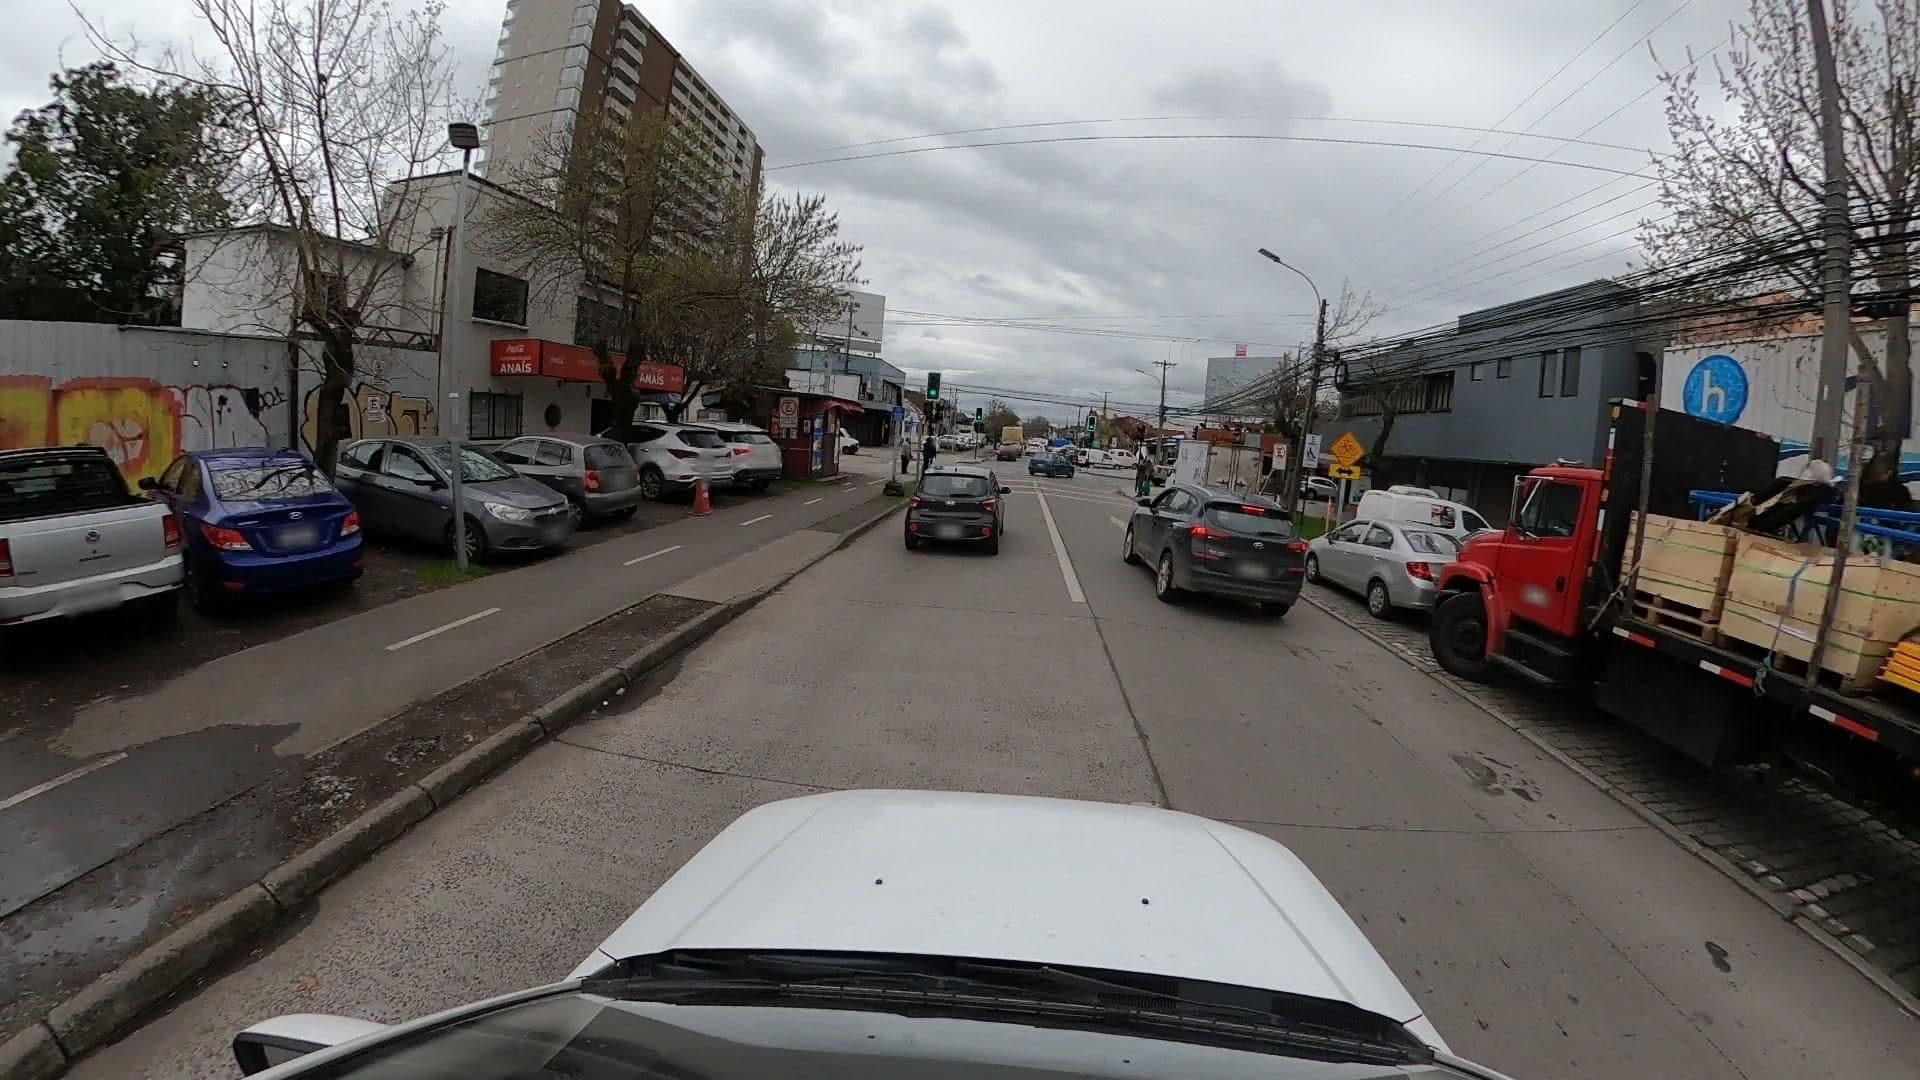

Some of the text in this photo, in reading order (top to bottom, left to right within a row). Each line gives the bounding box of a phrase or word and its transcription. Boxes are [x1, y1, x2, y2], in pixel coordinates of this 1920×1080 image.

[500, 361, 532, 374] ANAÍS
[640, 372, 665, 385] ANAÍS
[1701, 369, 1726, 413] h
